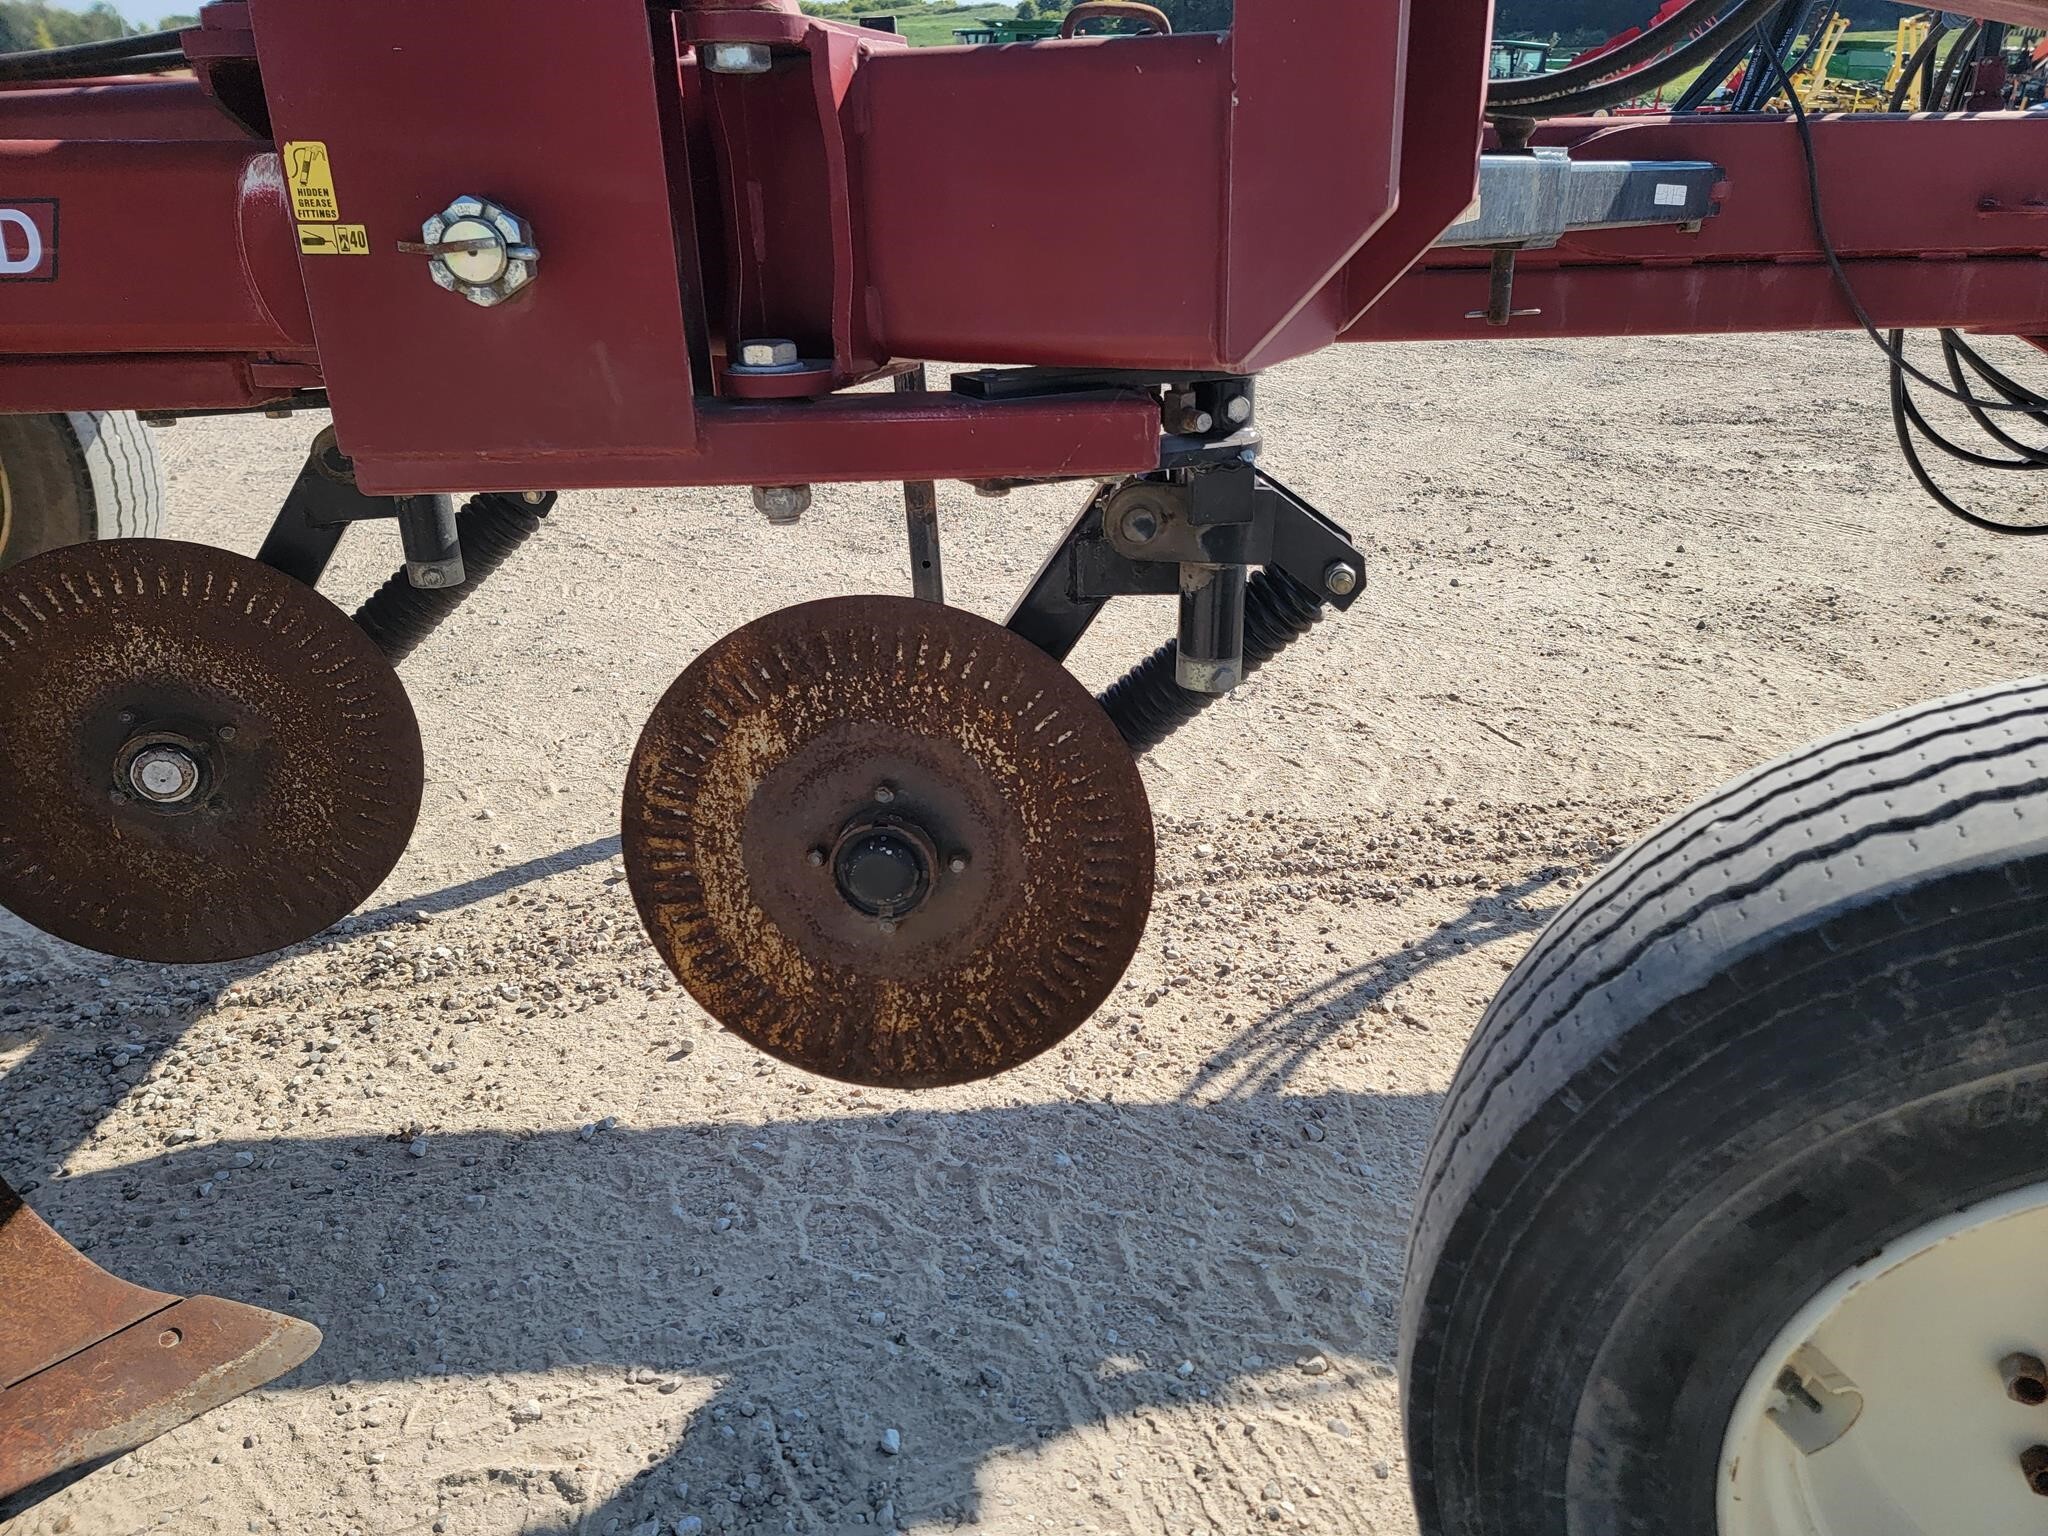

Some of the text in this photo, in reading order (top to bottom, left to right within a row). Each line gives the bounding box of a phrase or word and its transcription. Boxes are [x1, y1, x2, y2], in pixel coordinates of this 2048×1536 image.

[297, 188, 329, 197] HIDDEN
[298, 199, 332, 208] GREASE
[298, 209, 337, 218] FITTINGS
[0, 208, 42, 274] D
[350, 230, 366, 248] 40
